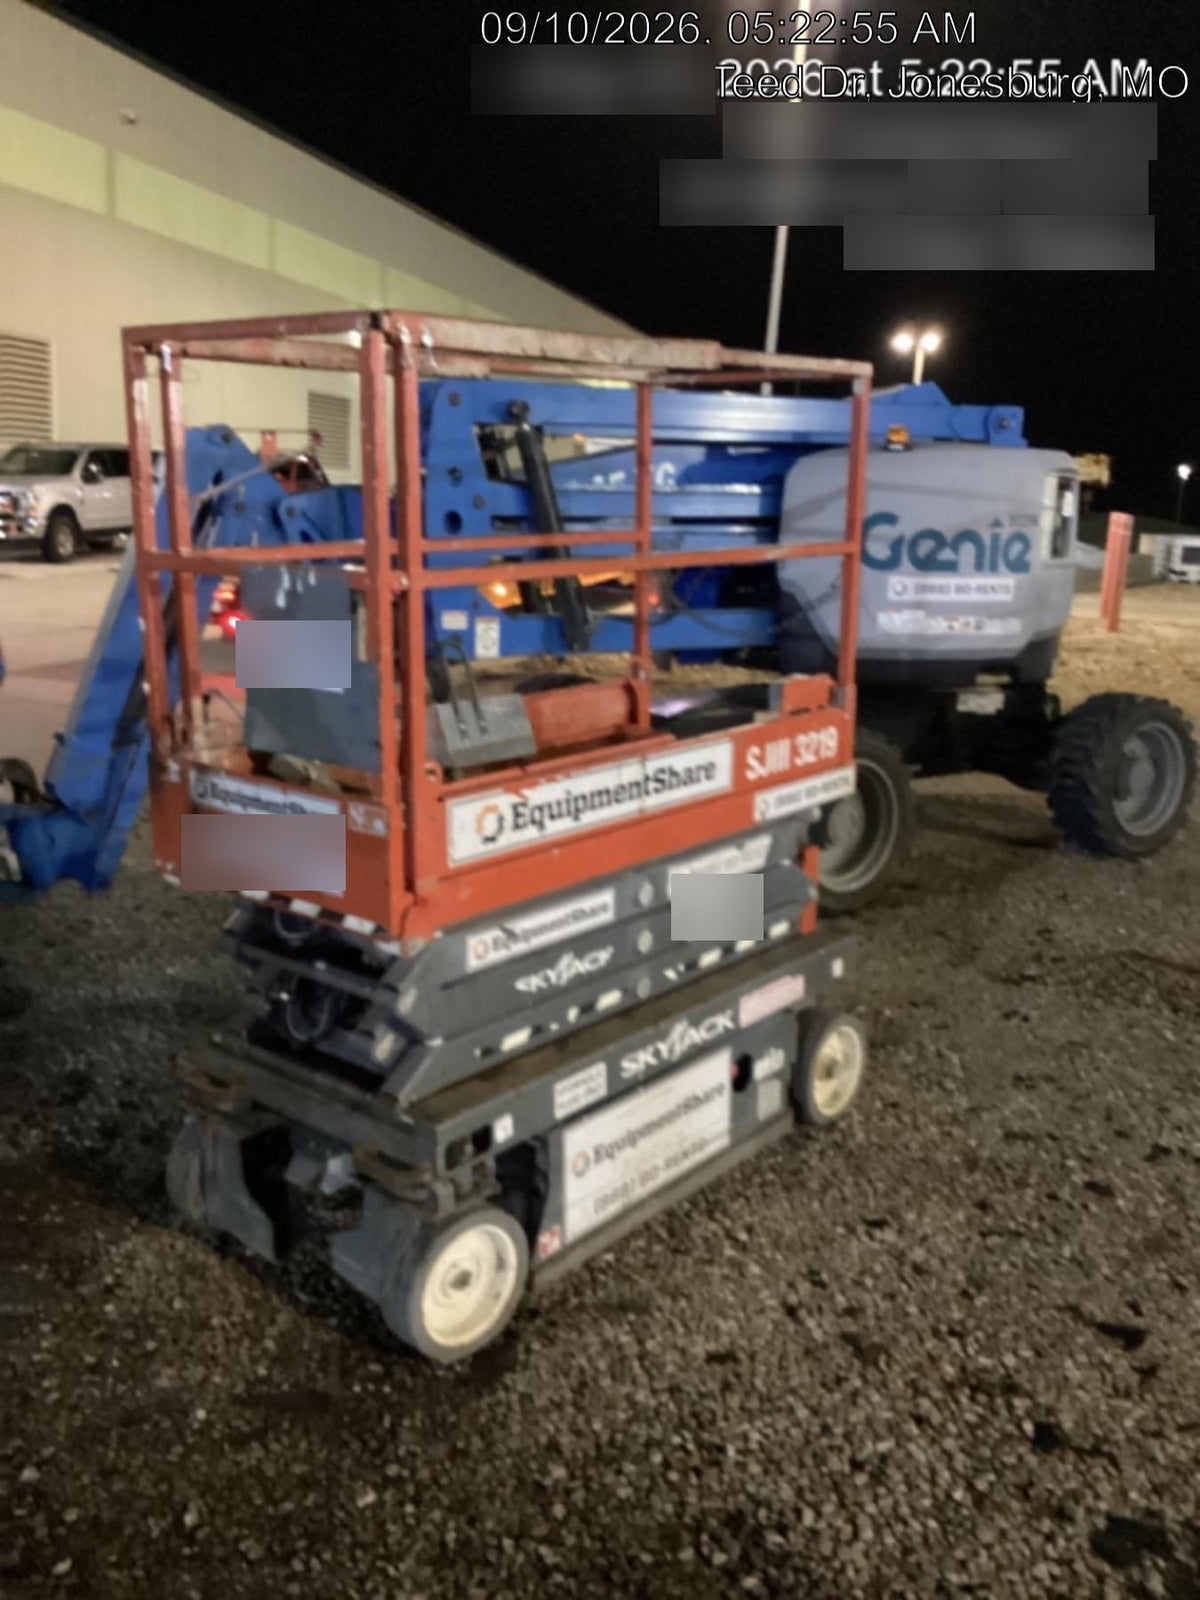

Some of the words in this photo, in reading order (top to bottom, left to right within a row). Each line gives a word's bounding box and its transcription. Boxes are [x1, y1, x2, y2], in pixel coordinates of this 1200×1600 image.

[860, 511, 1031, 574] Genie
[794, 725, 839, 767] 3219
[511, 760, 717, 832] EquipmentShare
[619, 1009, 736, 1080] SKYJACK
